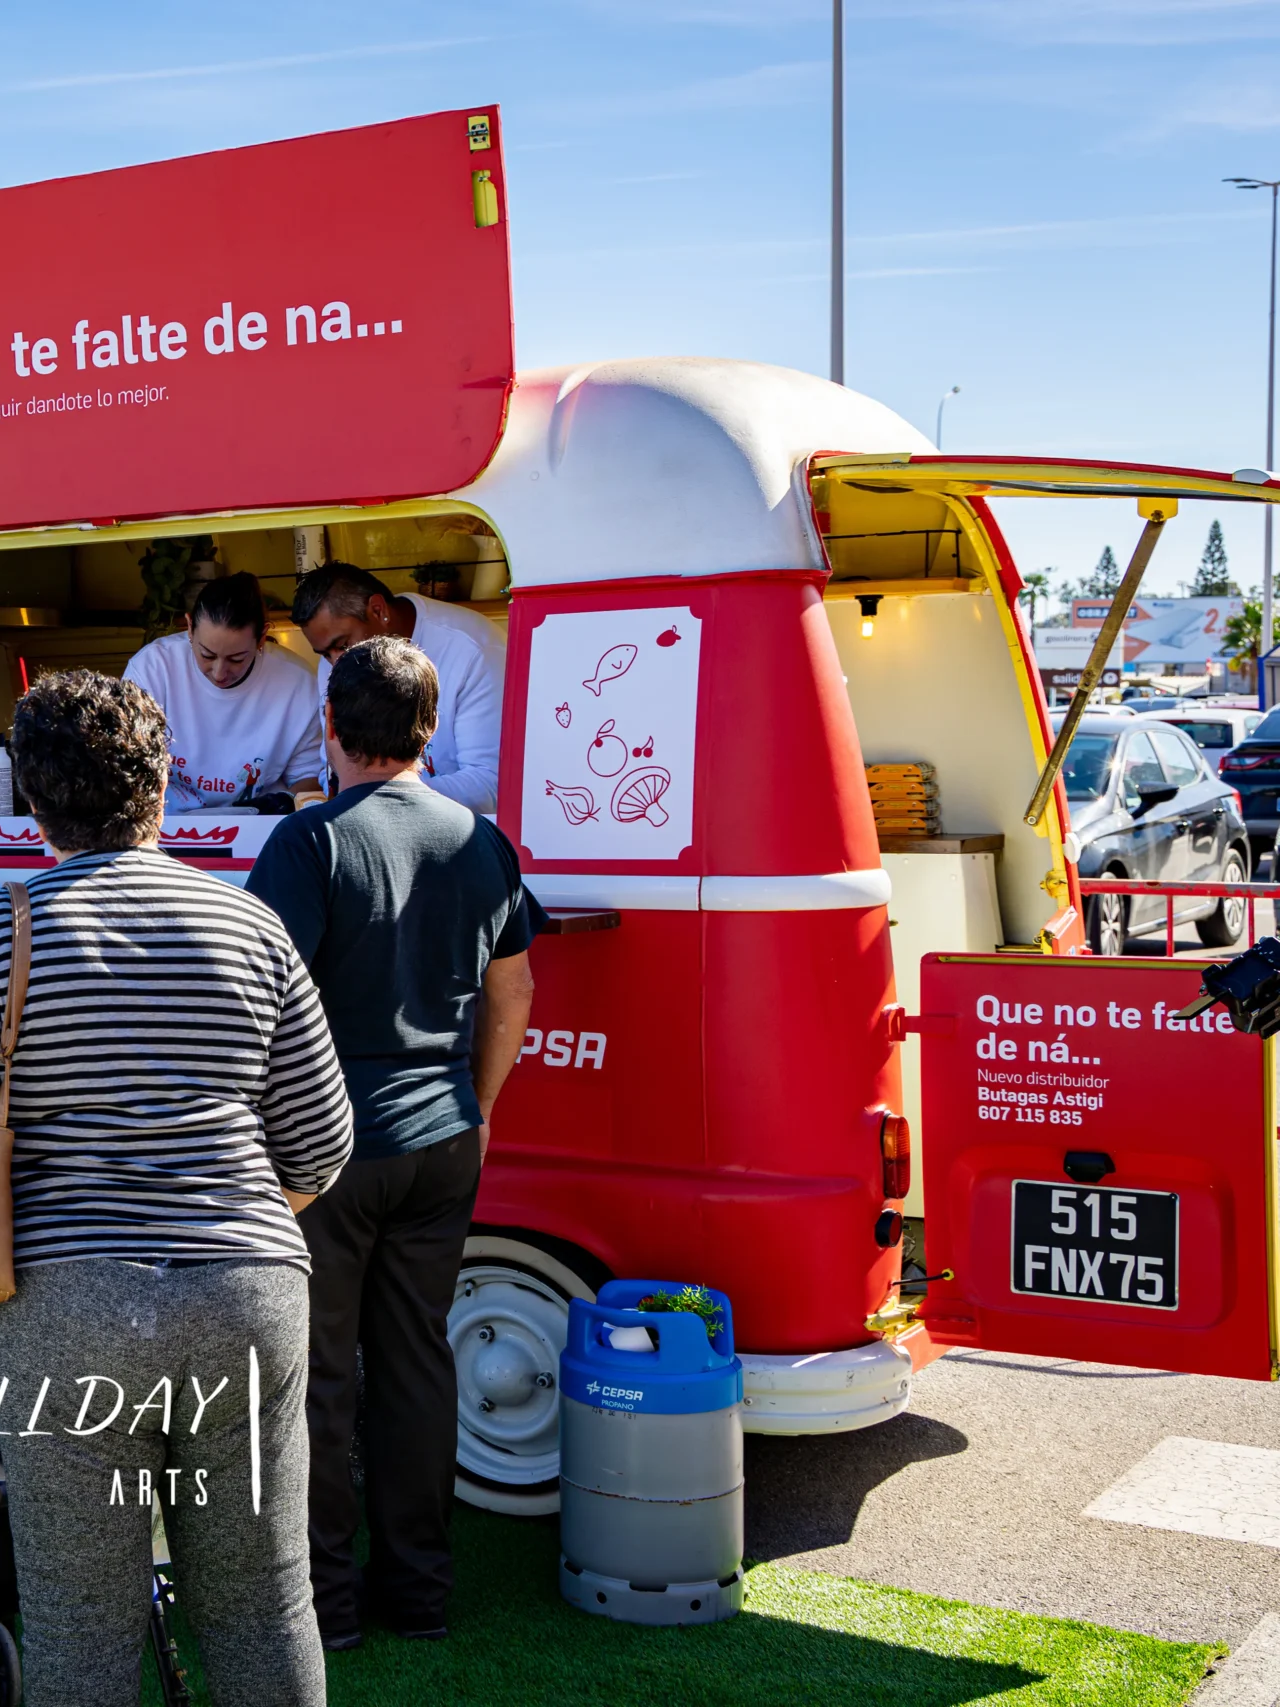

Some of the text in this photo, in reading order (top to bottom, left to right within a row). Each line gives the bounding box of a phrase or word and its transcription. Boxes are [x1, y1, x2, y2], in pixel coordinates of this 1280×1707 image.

[10, 331, 58, 377] te
[71, 314, 188, 370] falte
[203, 301, 268, 355] de
[285, 300, 403, 346] na...
[26, 392, 92, 415] dandote
[97, 388, 113, 407] lo
[117, 383, 170, 407] mejor.
[1052, 673, 1081, 684] salid
[177, 770, 192, 785] te
[197, 775, 236, 793] falte
[976, 994, 1044, 1026] Que
[1054, 1004, 1097, 1027] no
[1106, 1001, 1141, 1029] te
[515, 1028, 607, 1069] PSA
[976, 1032, 1101, 1065] de ná...
[977, 1068, 1110, 1089] Nuevo distribuidor
[977, 1086, 1103, 1111] Butagas Astigi
[978, 1105, 1083, 1126] 607 115 835
[1050, 1189, 1137, 1241] 515
[601, 1386, 644, 1401] CEPSA
[601, 1399, 634, 1411] PROPANO
